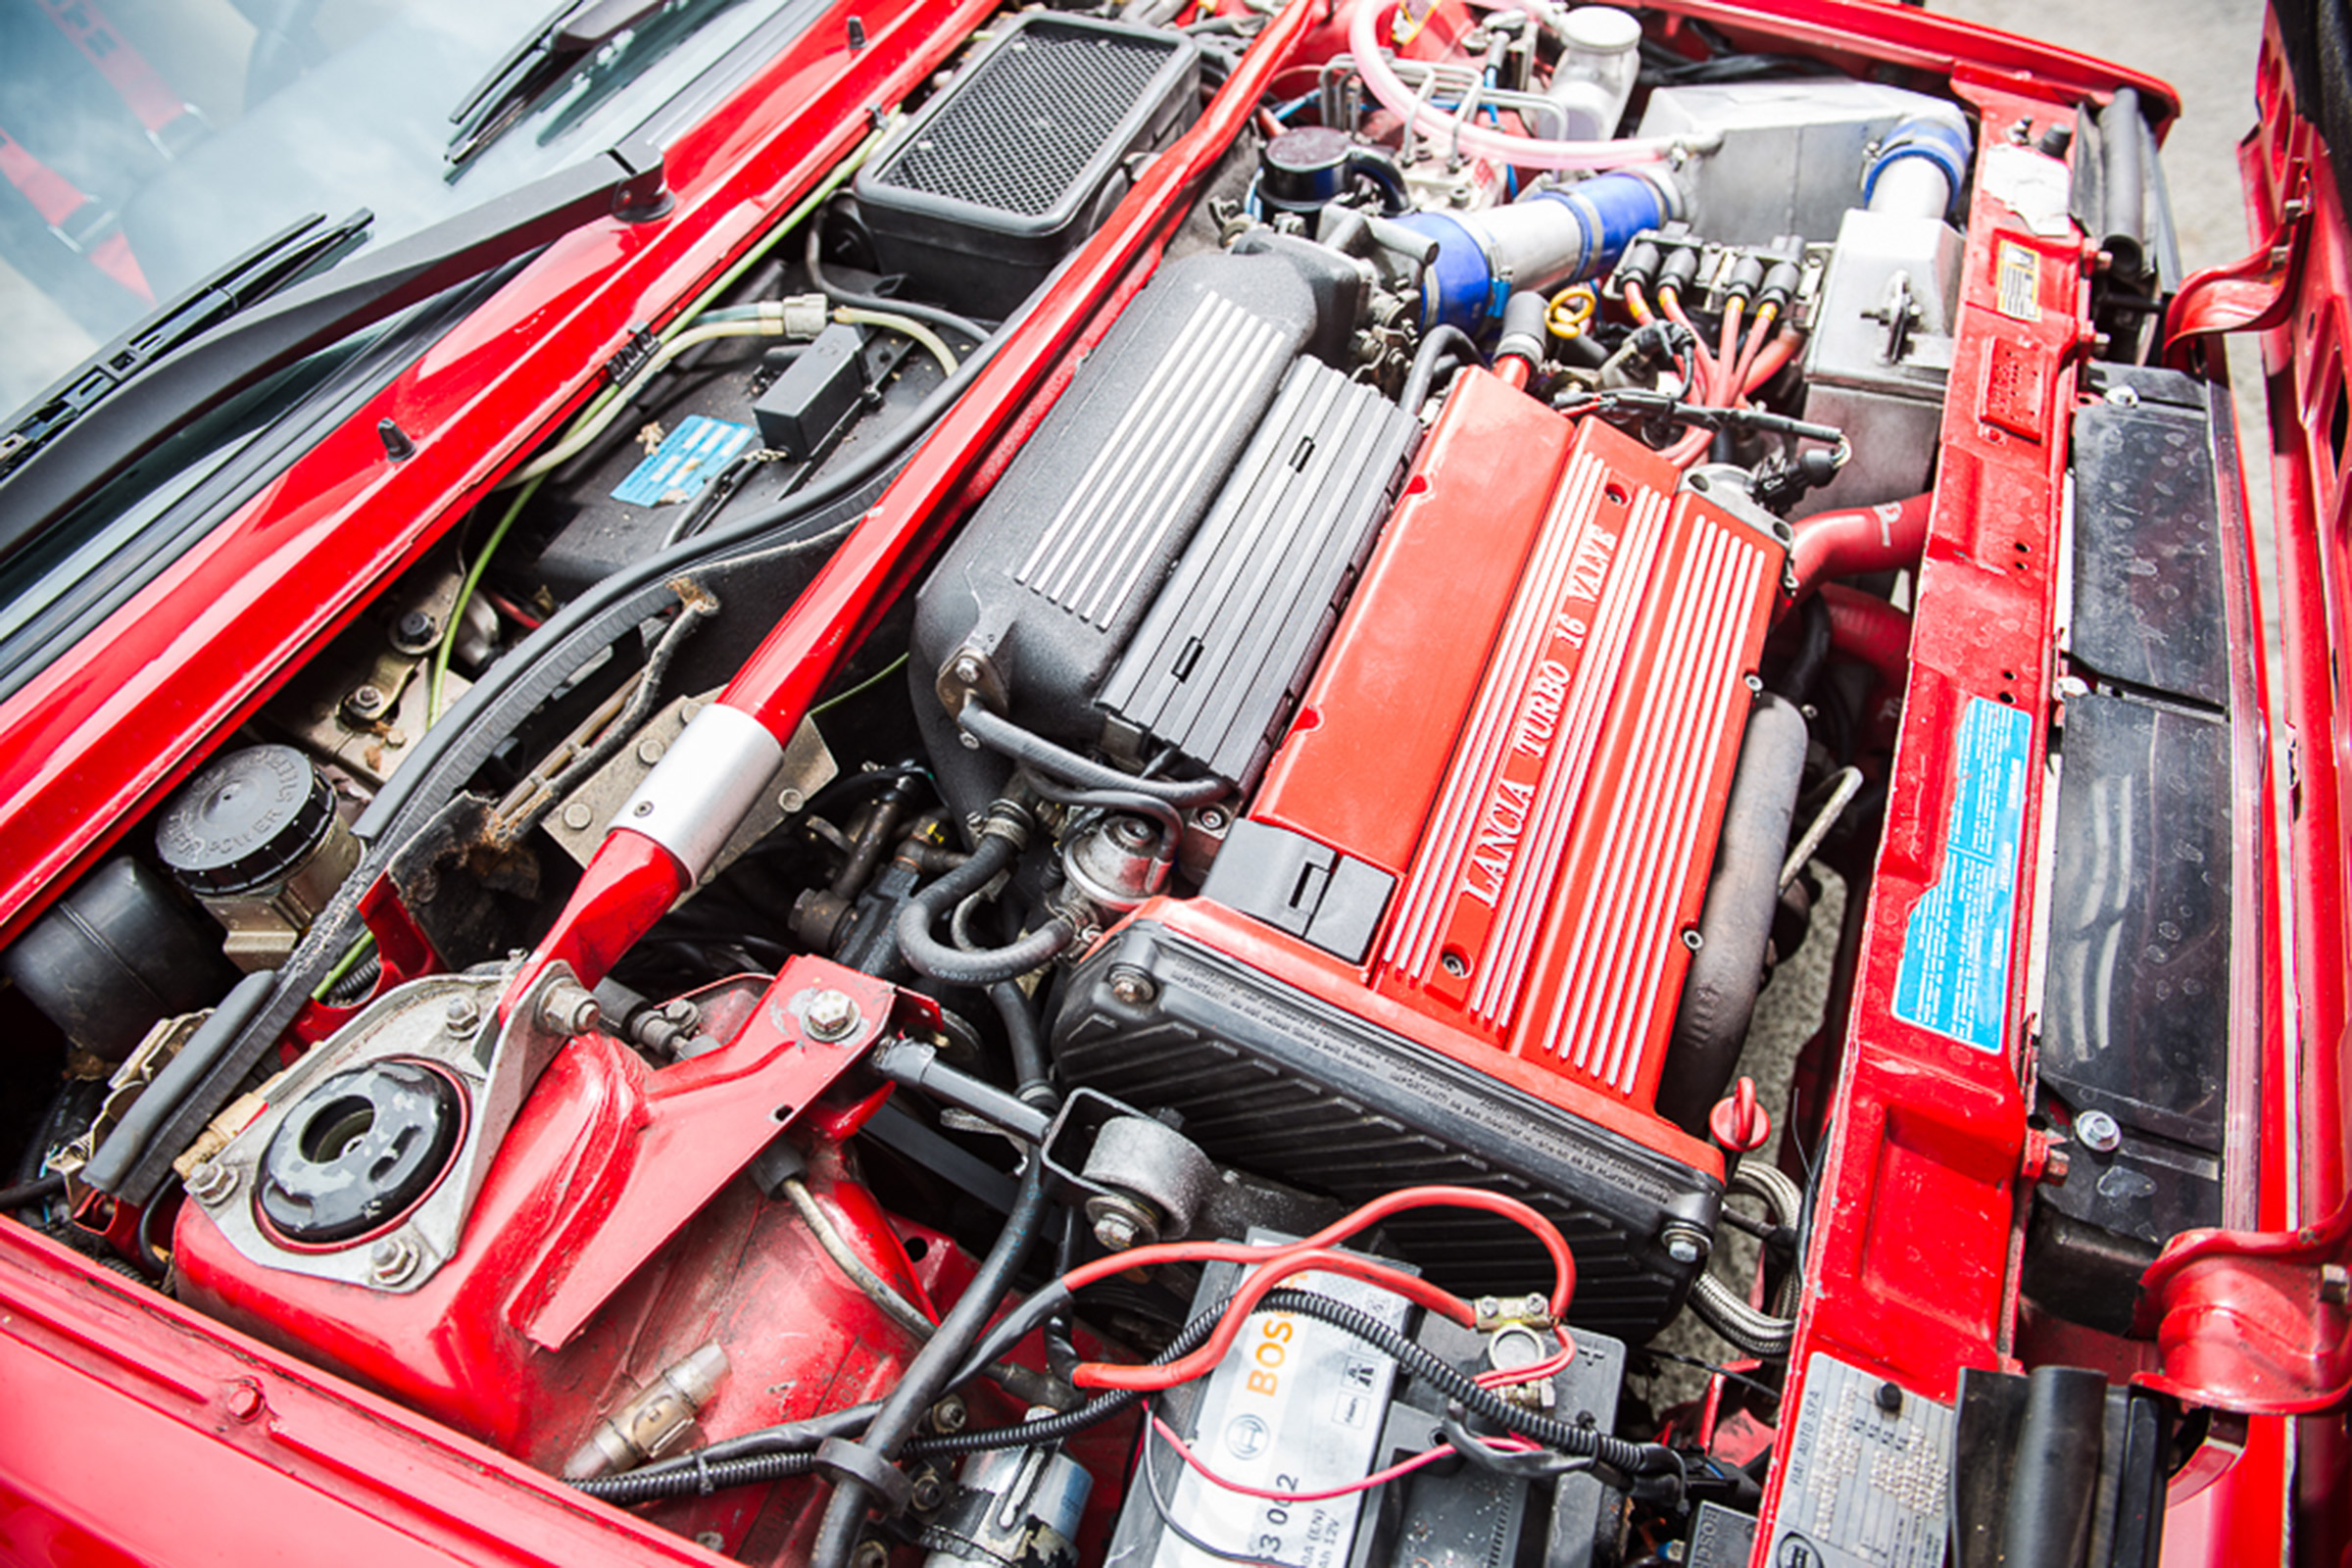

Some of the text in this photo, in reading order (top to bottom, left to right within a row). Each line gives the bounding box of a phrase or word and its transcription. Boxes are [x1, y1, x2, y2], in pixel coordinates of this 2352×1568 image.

[1461, 522, 1618, 908] LANCIA TURBO 16 VALVE
[1246, 1272, 1308, 1397] BOS
[1789, 1460, 1804, 1487] FIAT
[1797, 1422, 1813, 1456] AUTO
[1324, 1517, 1340, 1545] 12V
